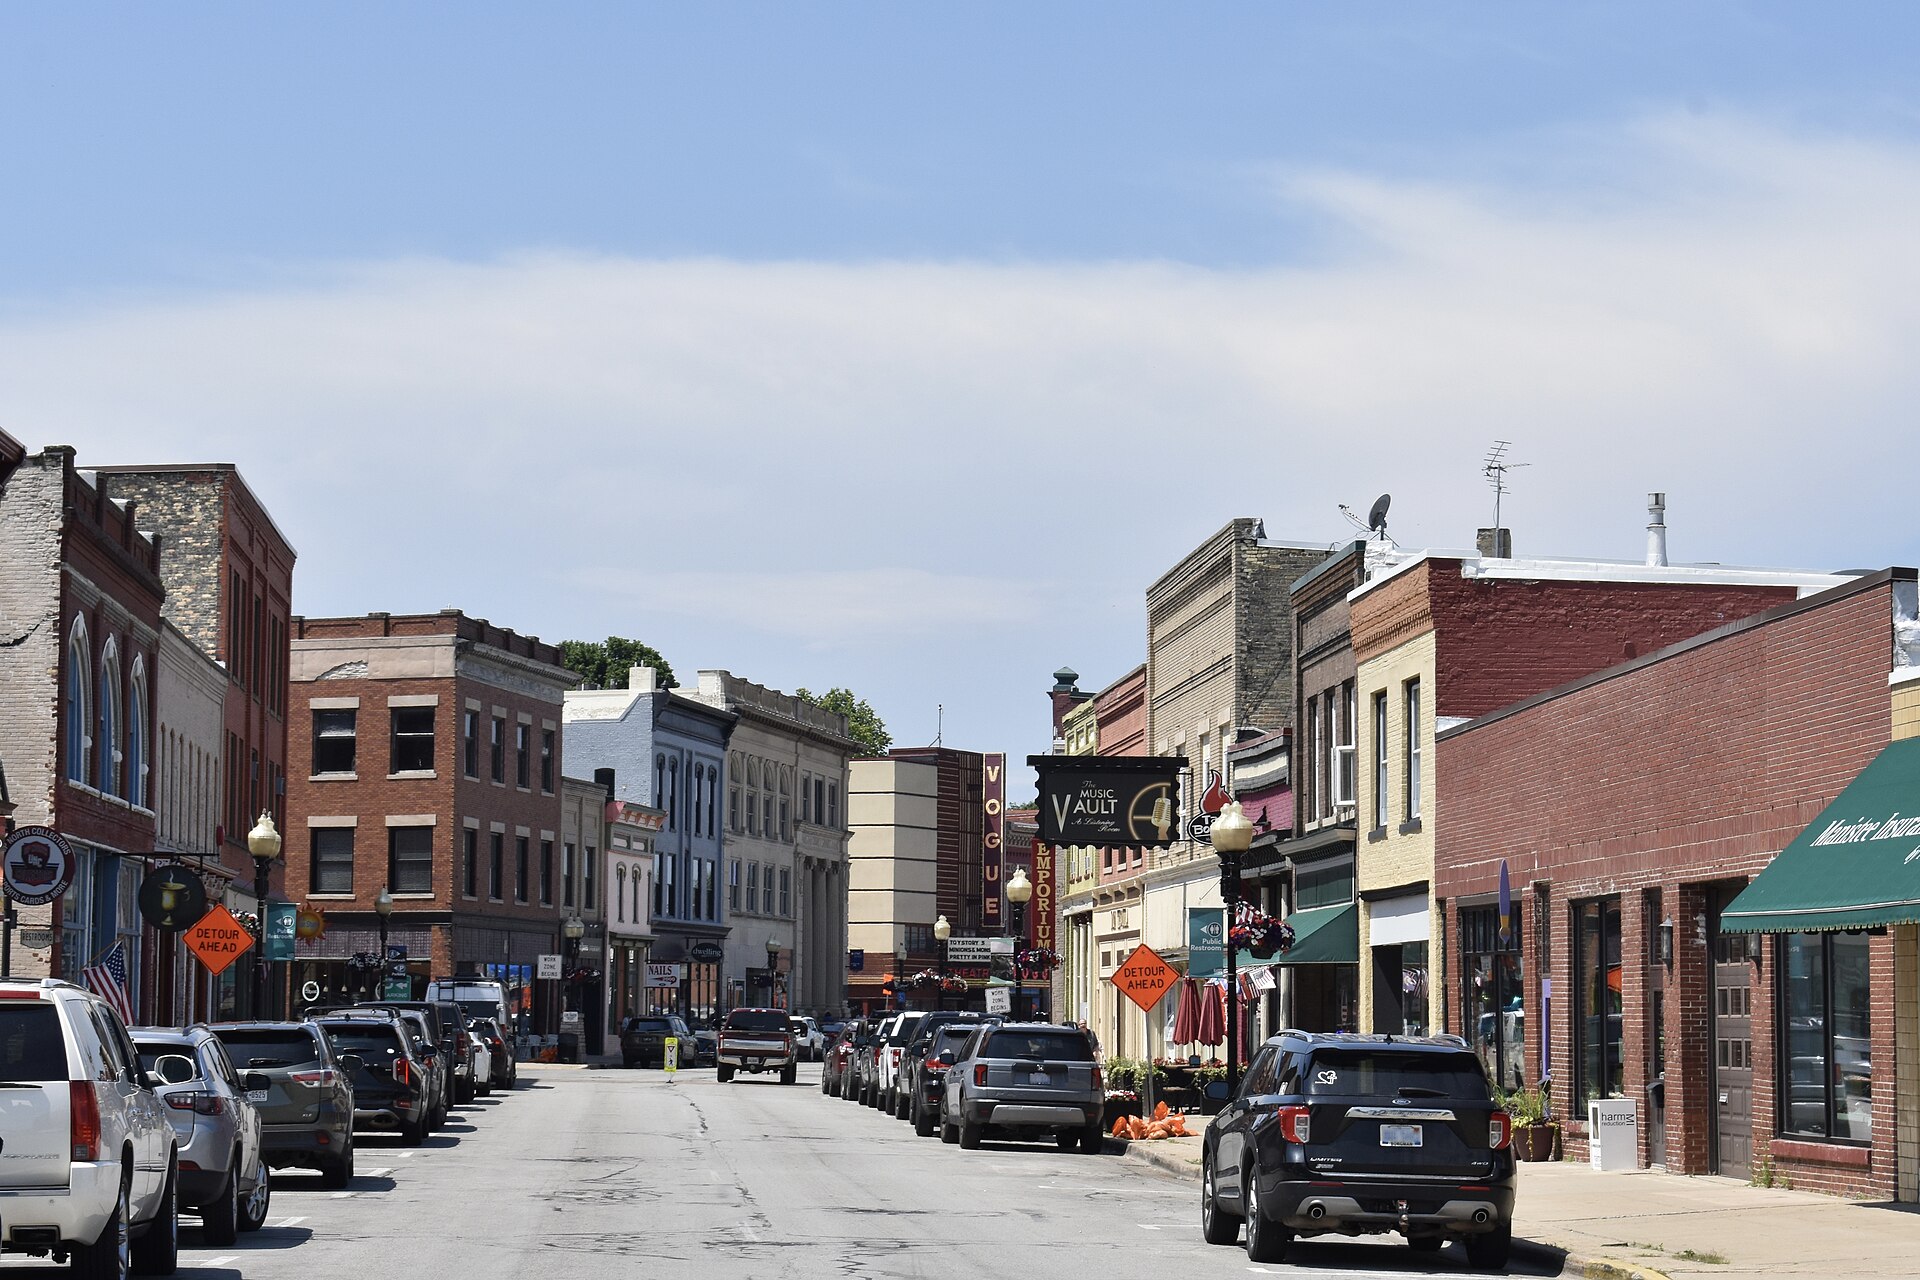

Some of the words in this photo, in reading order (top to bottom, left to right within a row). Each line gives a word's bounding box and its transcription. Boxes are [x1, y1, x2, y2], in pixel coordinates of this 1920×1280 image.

[1082, 780, 1096, 788] The
[1080, 789, 1114, 798] MUSIC
[1052, 794, 1118, 834] VAULT
[7, 828, 31, 845] NORTH
[31, 827, 71, 855] COLLECTORS
[985, 765, 1001, 914] VOGUE
[3, 880, 20, 901] PORTS
[20, 895, 45, 905] CARDS
[51, 880, 69, 898] MORE
[1037, 843, 1051, 949] EMPORIUM
[22, 931, 53, 941] RESTROOMS
[196, 928, 240, 940] DETOUR
[198, 941, 237, 953] AHEAD
[693, 948, 722, 957] dwelling
[649, 965, 672, 976] NAILS
[1124, 967, 1165, 978] DETOUR
[1127, 979, 1164, 990] AHEAD
[1601, 1112, 1625, 1121] harm
